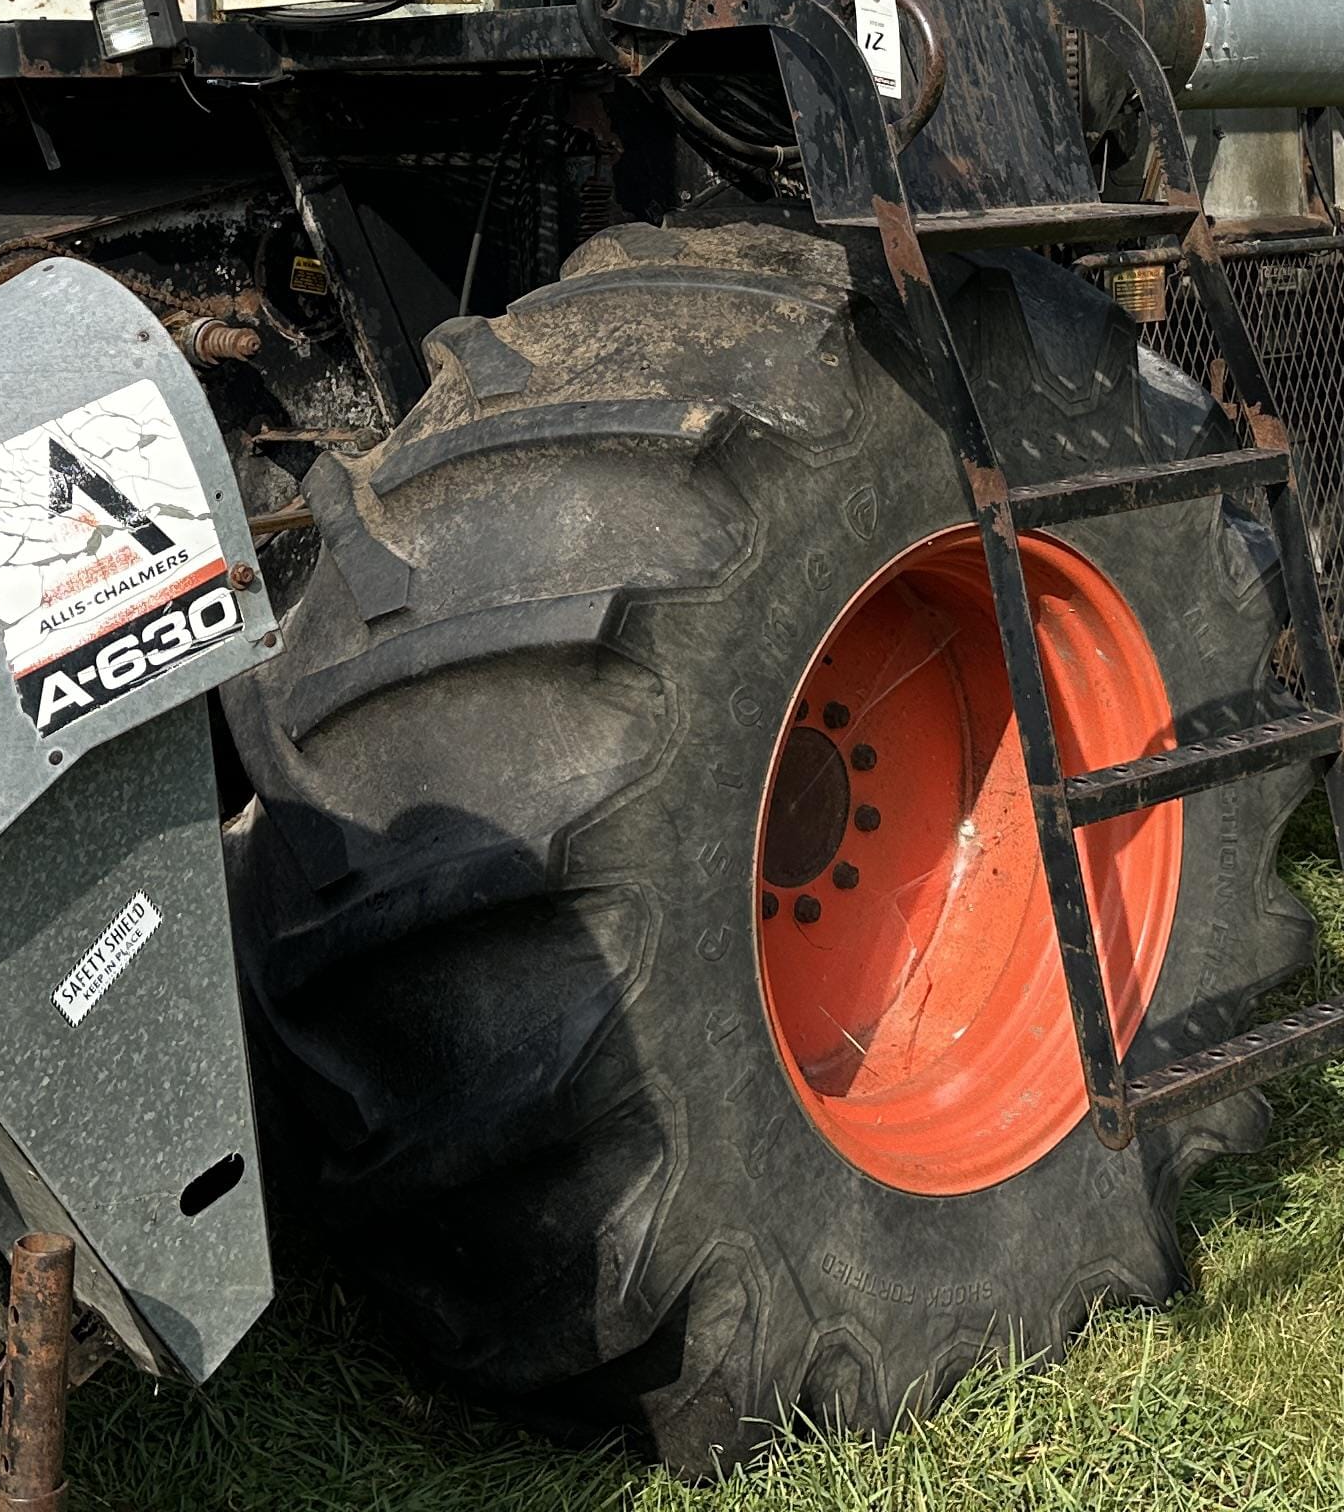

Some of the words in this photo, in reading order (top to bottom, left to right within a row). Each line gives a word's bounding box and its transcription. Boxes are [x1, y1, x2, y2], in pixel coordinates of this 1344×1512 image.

[864, 31, 888, 52] 12
[39, 549, 190, 634] ALLIS-CHALMERS
[36, 588, 238, 729] A-630
[62, 947, 106, 1005] SAFETY
[104, 902, 145, 953] SHIELD
[83, 973, 104, 1001] KEEP
[104, 961, 117, 976] IN
[114, 928, 143, 962] PLACE
